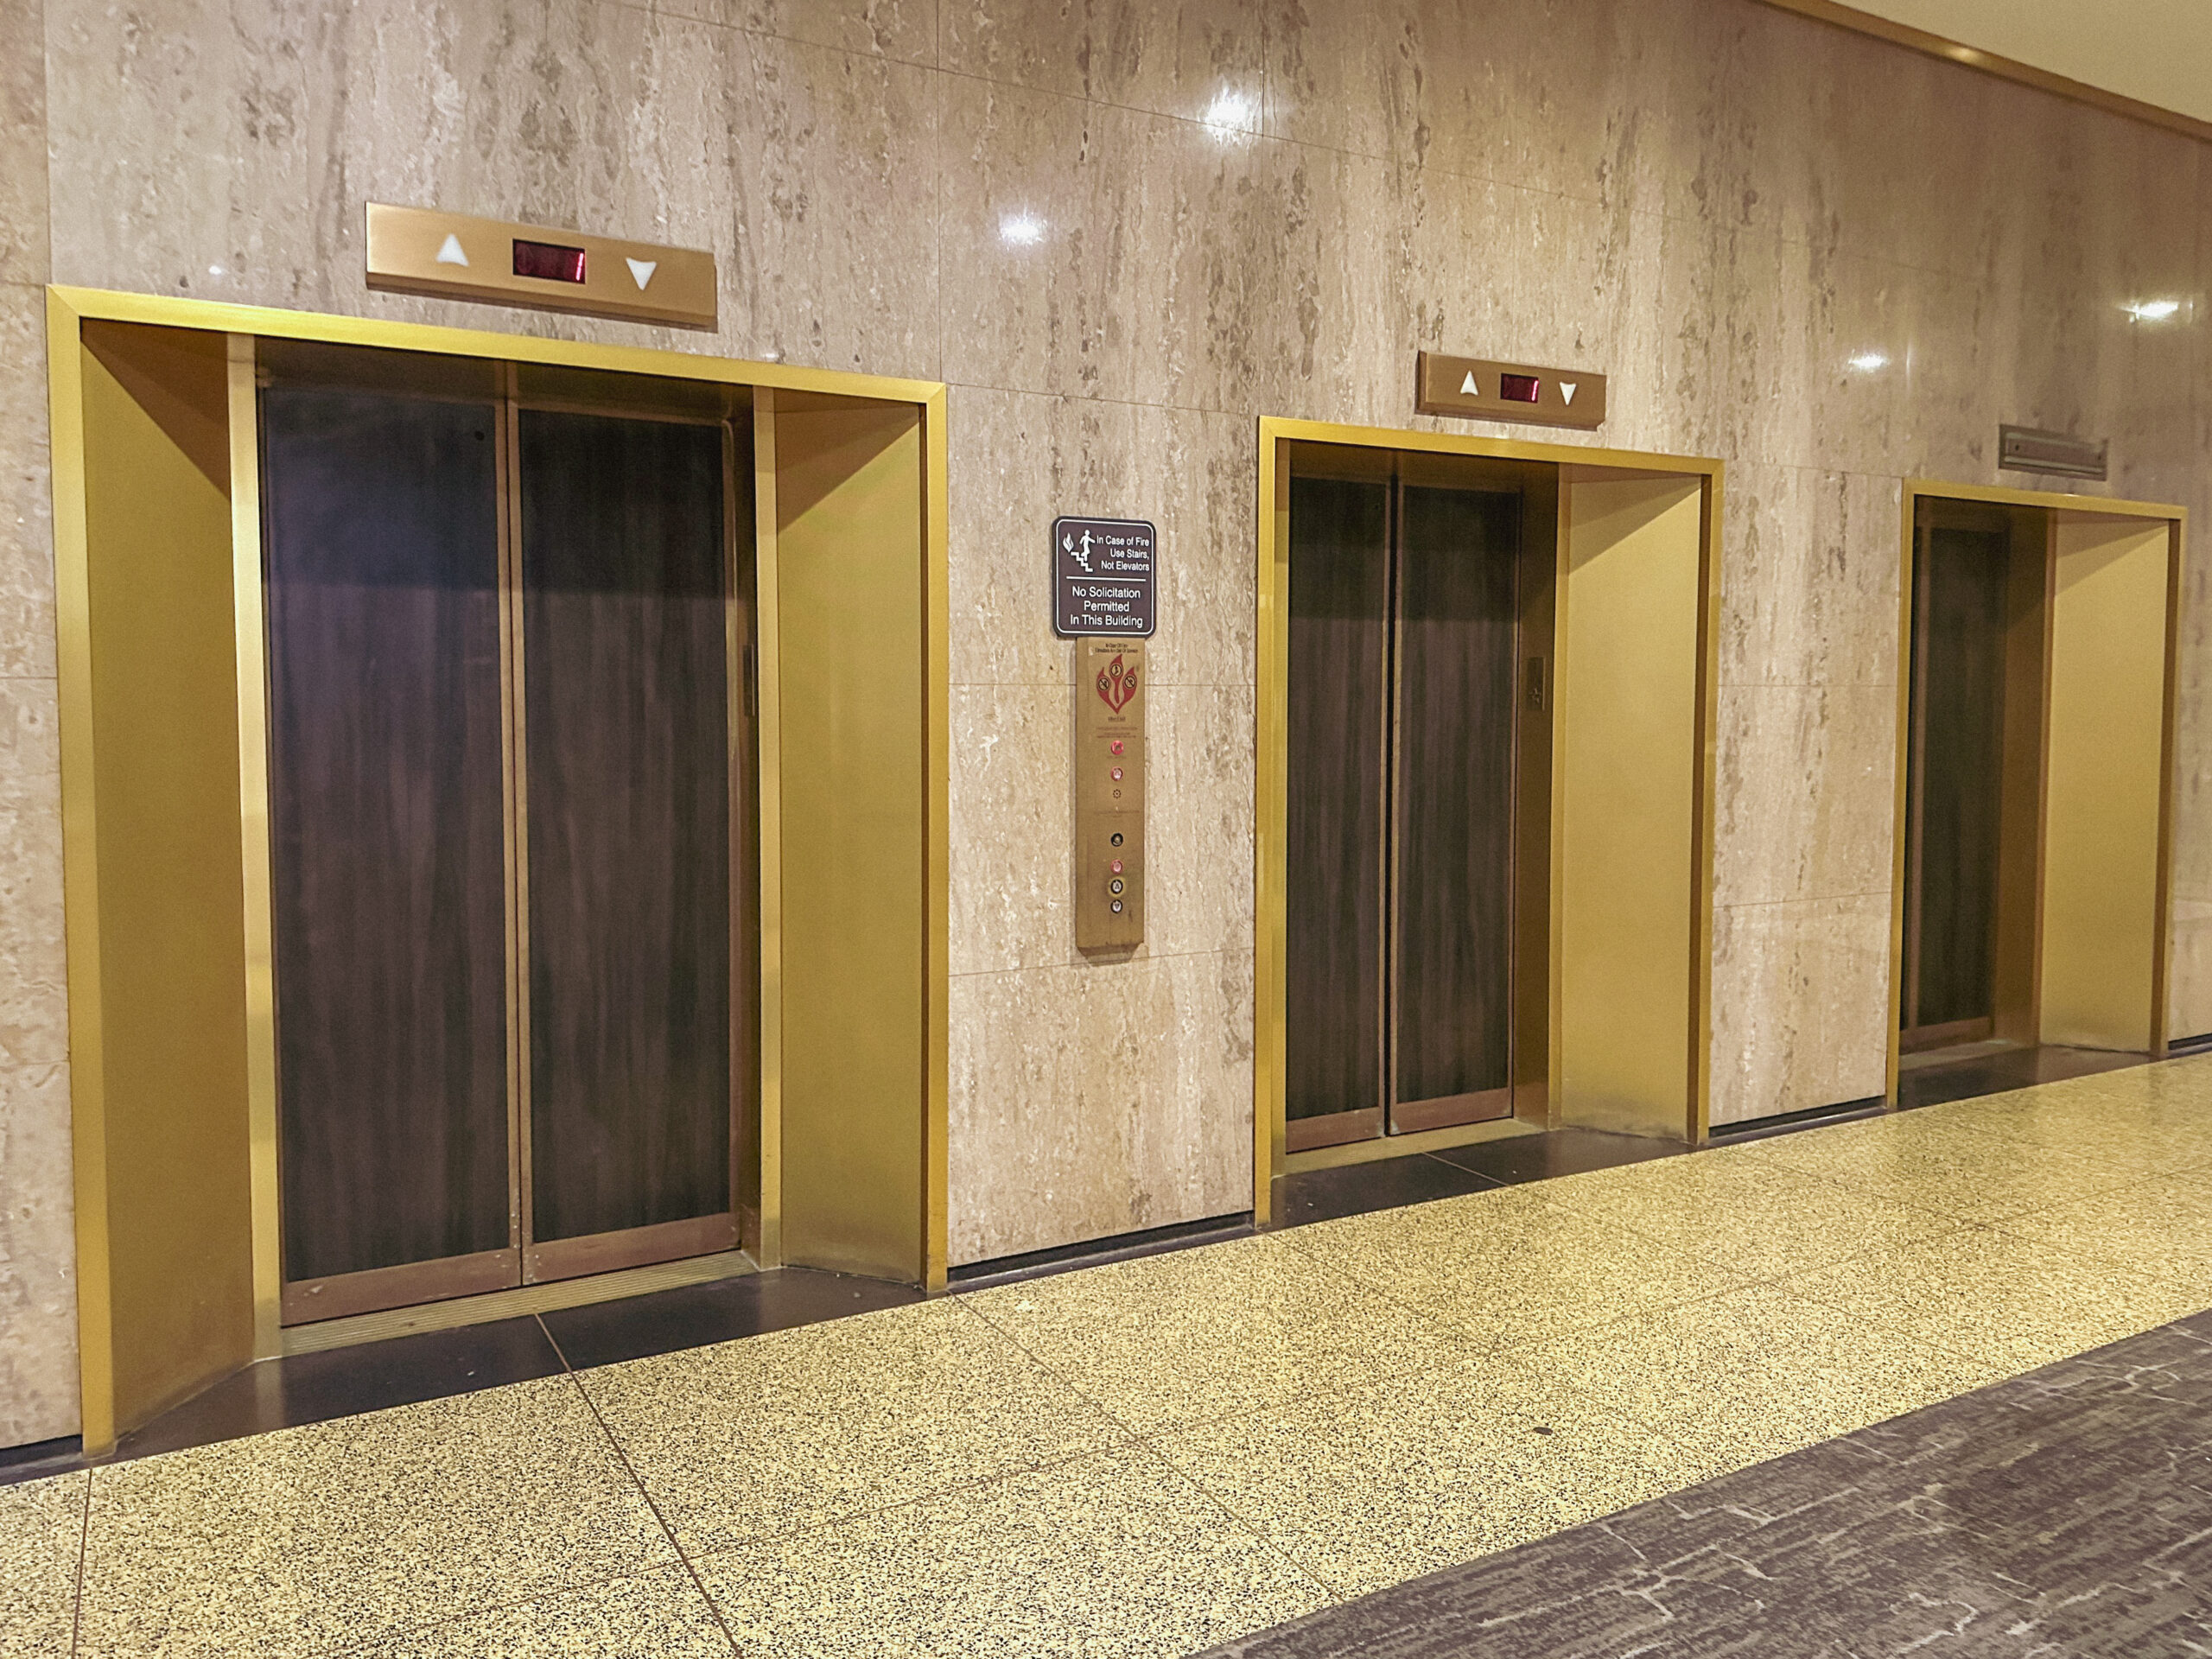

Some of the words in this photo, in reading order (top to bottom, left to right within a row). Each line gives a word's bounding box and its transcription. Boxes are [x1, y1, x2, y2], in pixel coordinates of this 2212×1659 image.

[1096, 534, 1104, 544] In
[1105, 535, 1125, 545] Case
[1126, 536, 1134, 546] of
[1135, 537, 1150, 547] Fire
[1109, 548, 1125, 558] Use
[1126, 549, 1149, 560] Stairs,
[1101, 560, 1115, 570] Not
[1116, 561, 1150, 571] Elevators
[1071, 586, 1086, 597] No
[1089, 586, 1141, 599] Solicitation
[1084, 600, 1130, 612] Permitted
[1070, 613, 1079, 625] In
[1081, 613, 1103, 626] This
[1105, 614, 1143, 629] Building
